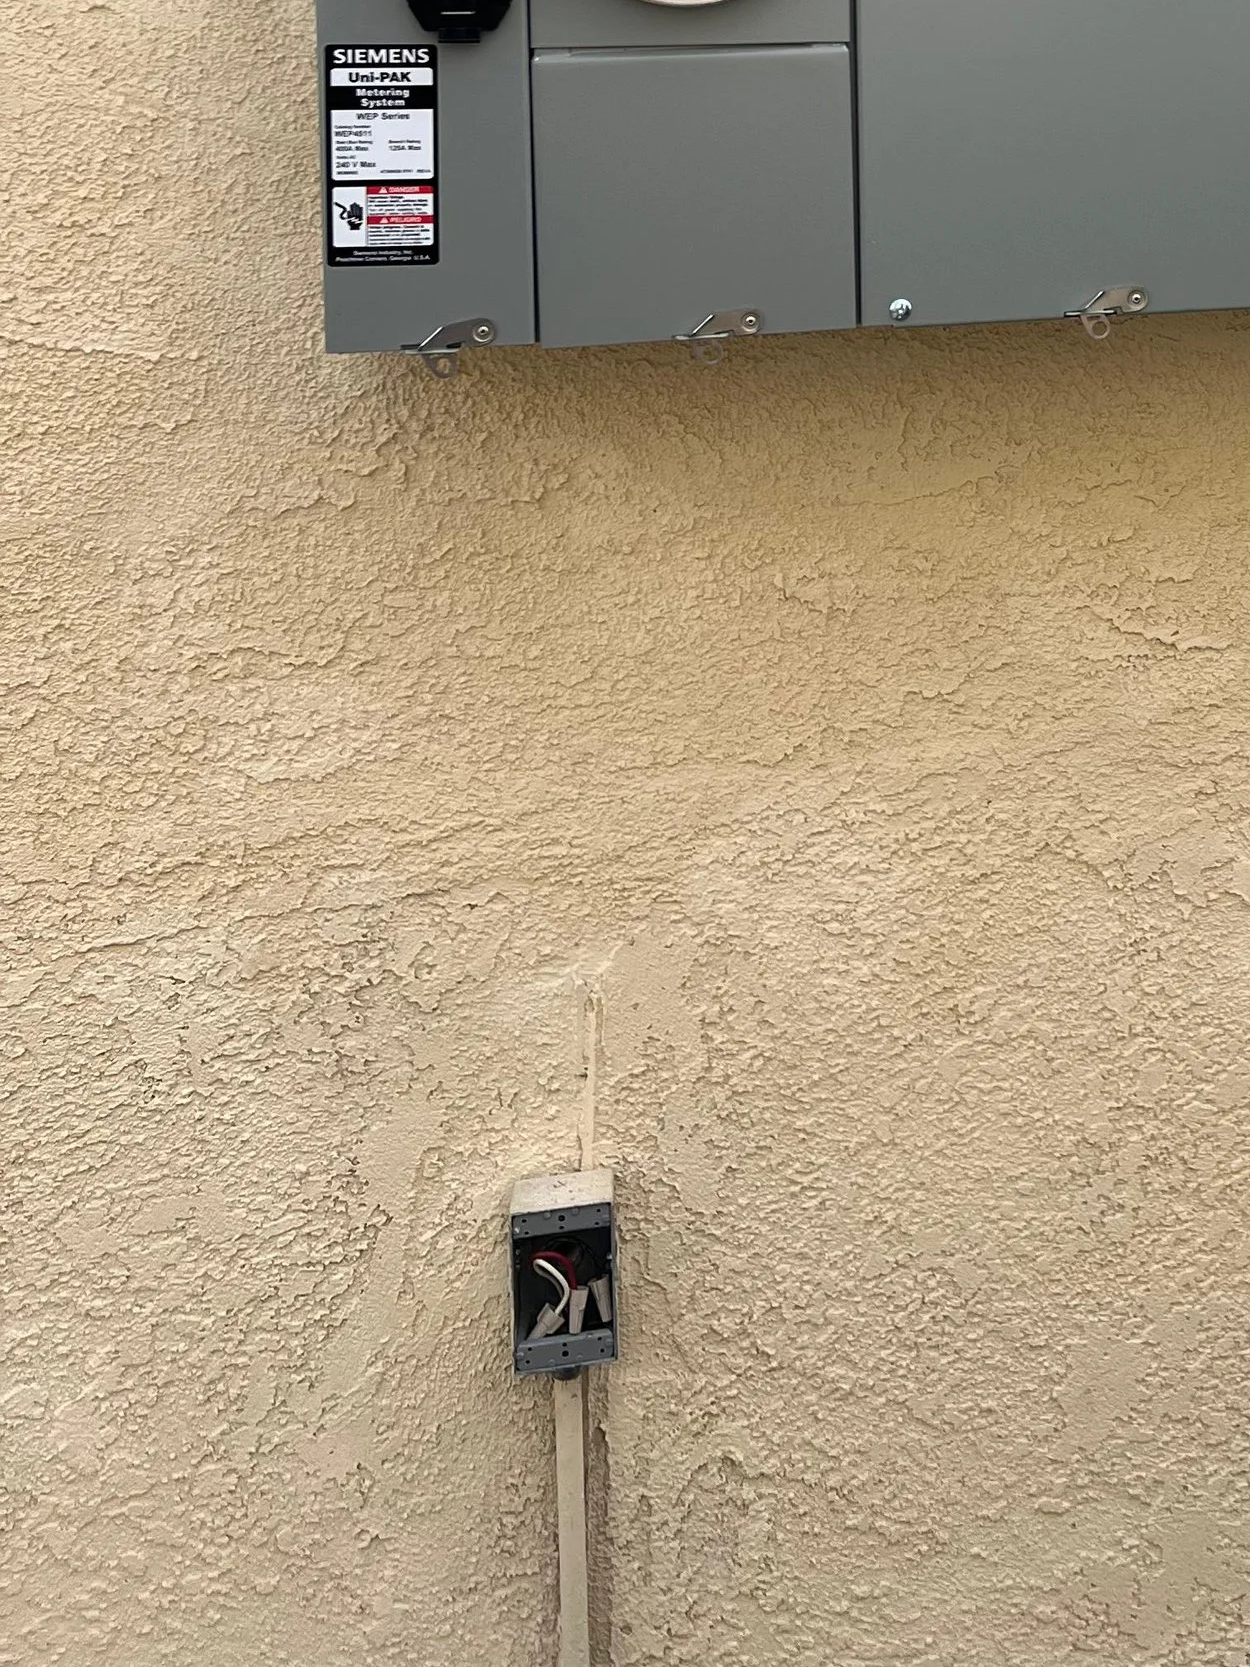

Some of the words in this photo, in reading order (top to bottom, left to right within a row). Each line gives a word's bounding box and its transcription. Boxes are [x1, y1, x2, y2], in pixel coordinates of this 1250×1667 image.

[333, 48, 430, 64] SIEMENS
[348, 71, 411, 83] Uni-PAK
[355, 88, 410, 98] Metering
[360, 98, 405, 108] System
[356, 112, 379, 120] WEP
[381, 112, 410, 120] Series
